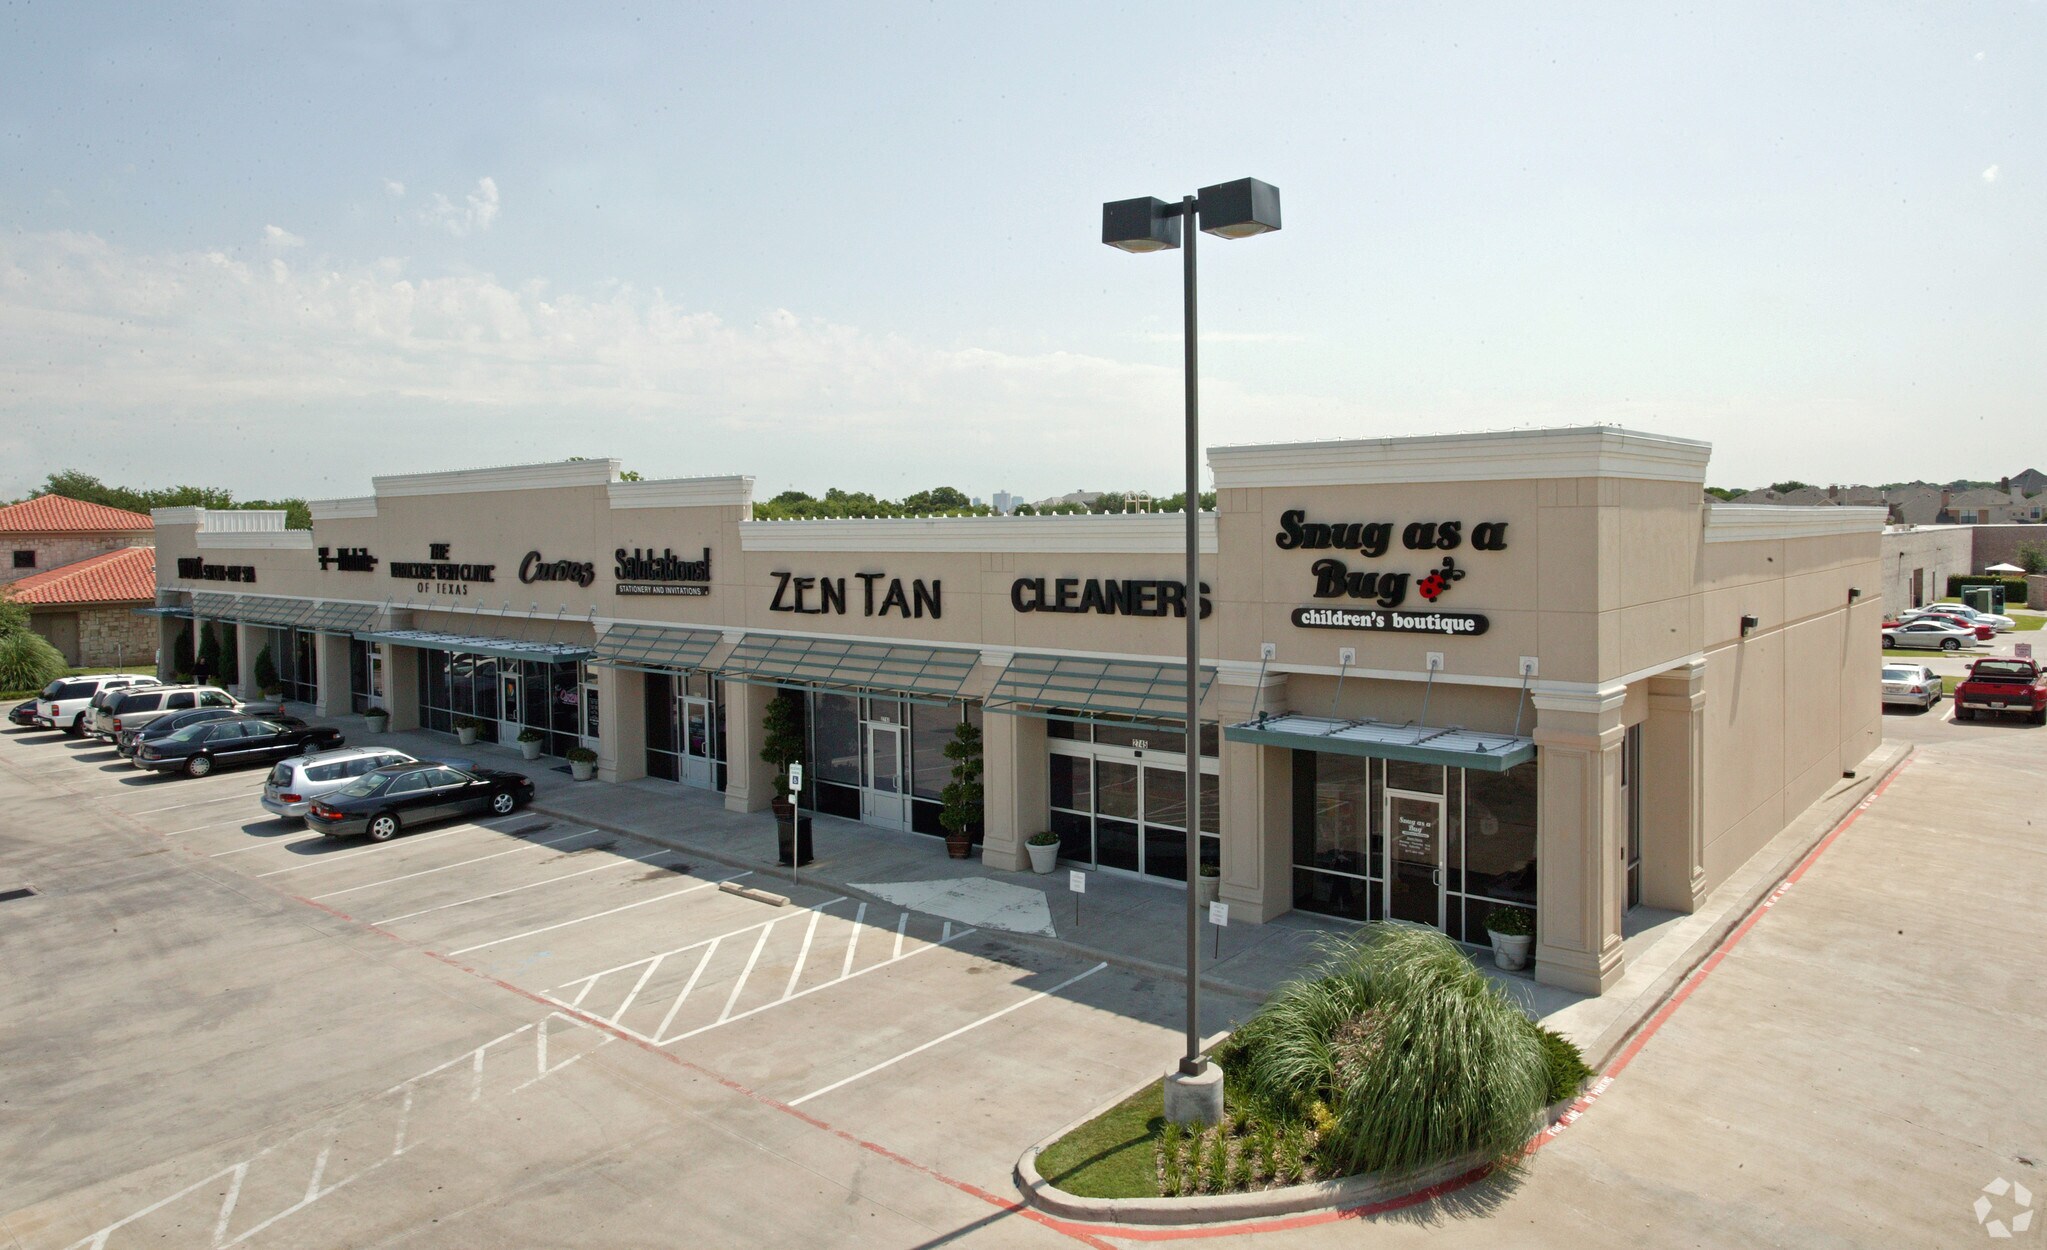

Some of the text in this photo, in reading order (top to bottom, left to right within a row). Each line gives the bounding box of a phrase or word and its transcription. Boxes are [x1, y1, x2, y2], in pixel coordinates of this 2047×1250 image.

[1275, 509, 1509, 558] Snug as a
[460, 564, 496, 583] CLINIC
[518, 550, 596, 587] Curves
[1311, 558, 1411, 608] Bug
[417, 582, 468, 596] OF TEXAS
[619, 585, 702, 597] STATIONERY AND INVITATIONS
[769, 571, 941, 619] ZEN TAN
[1011, 577, 1213, 620] CLEANERS
[1301, 609, 1475, 635] children's boutique
